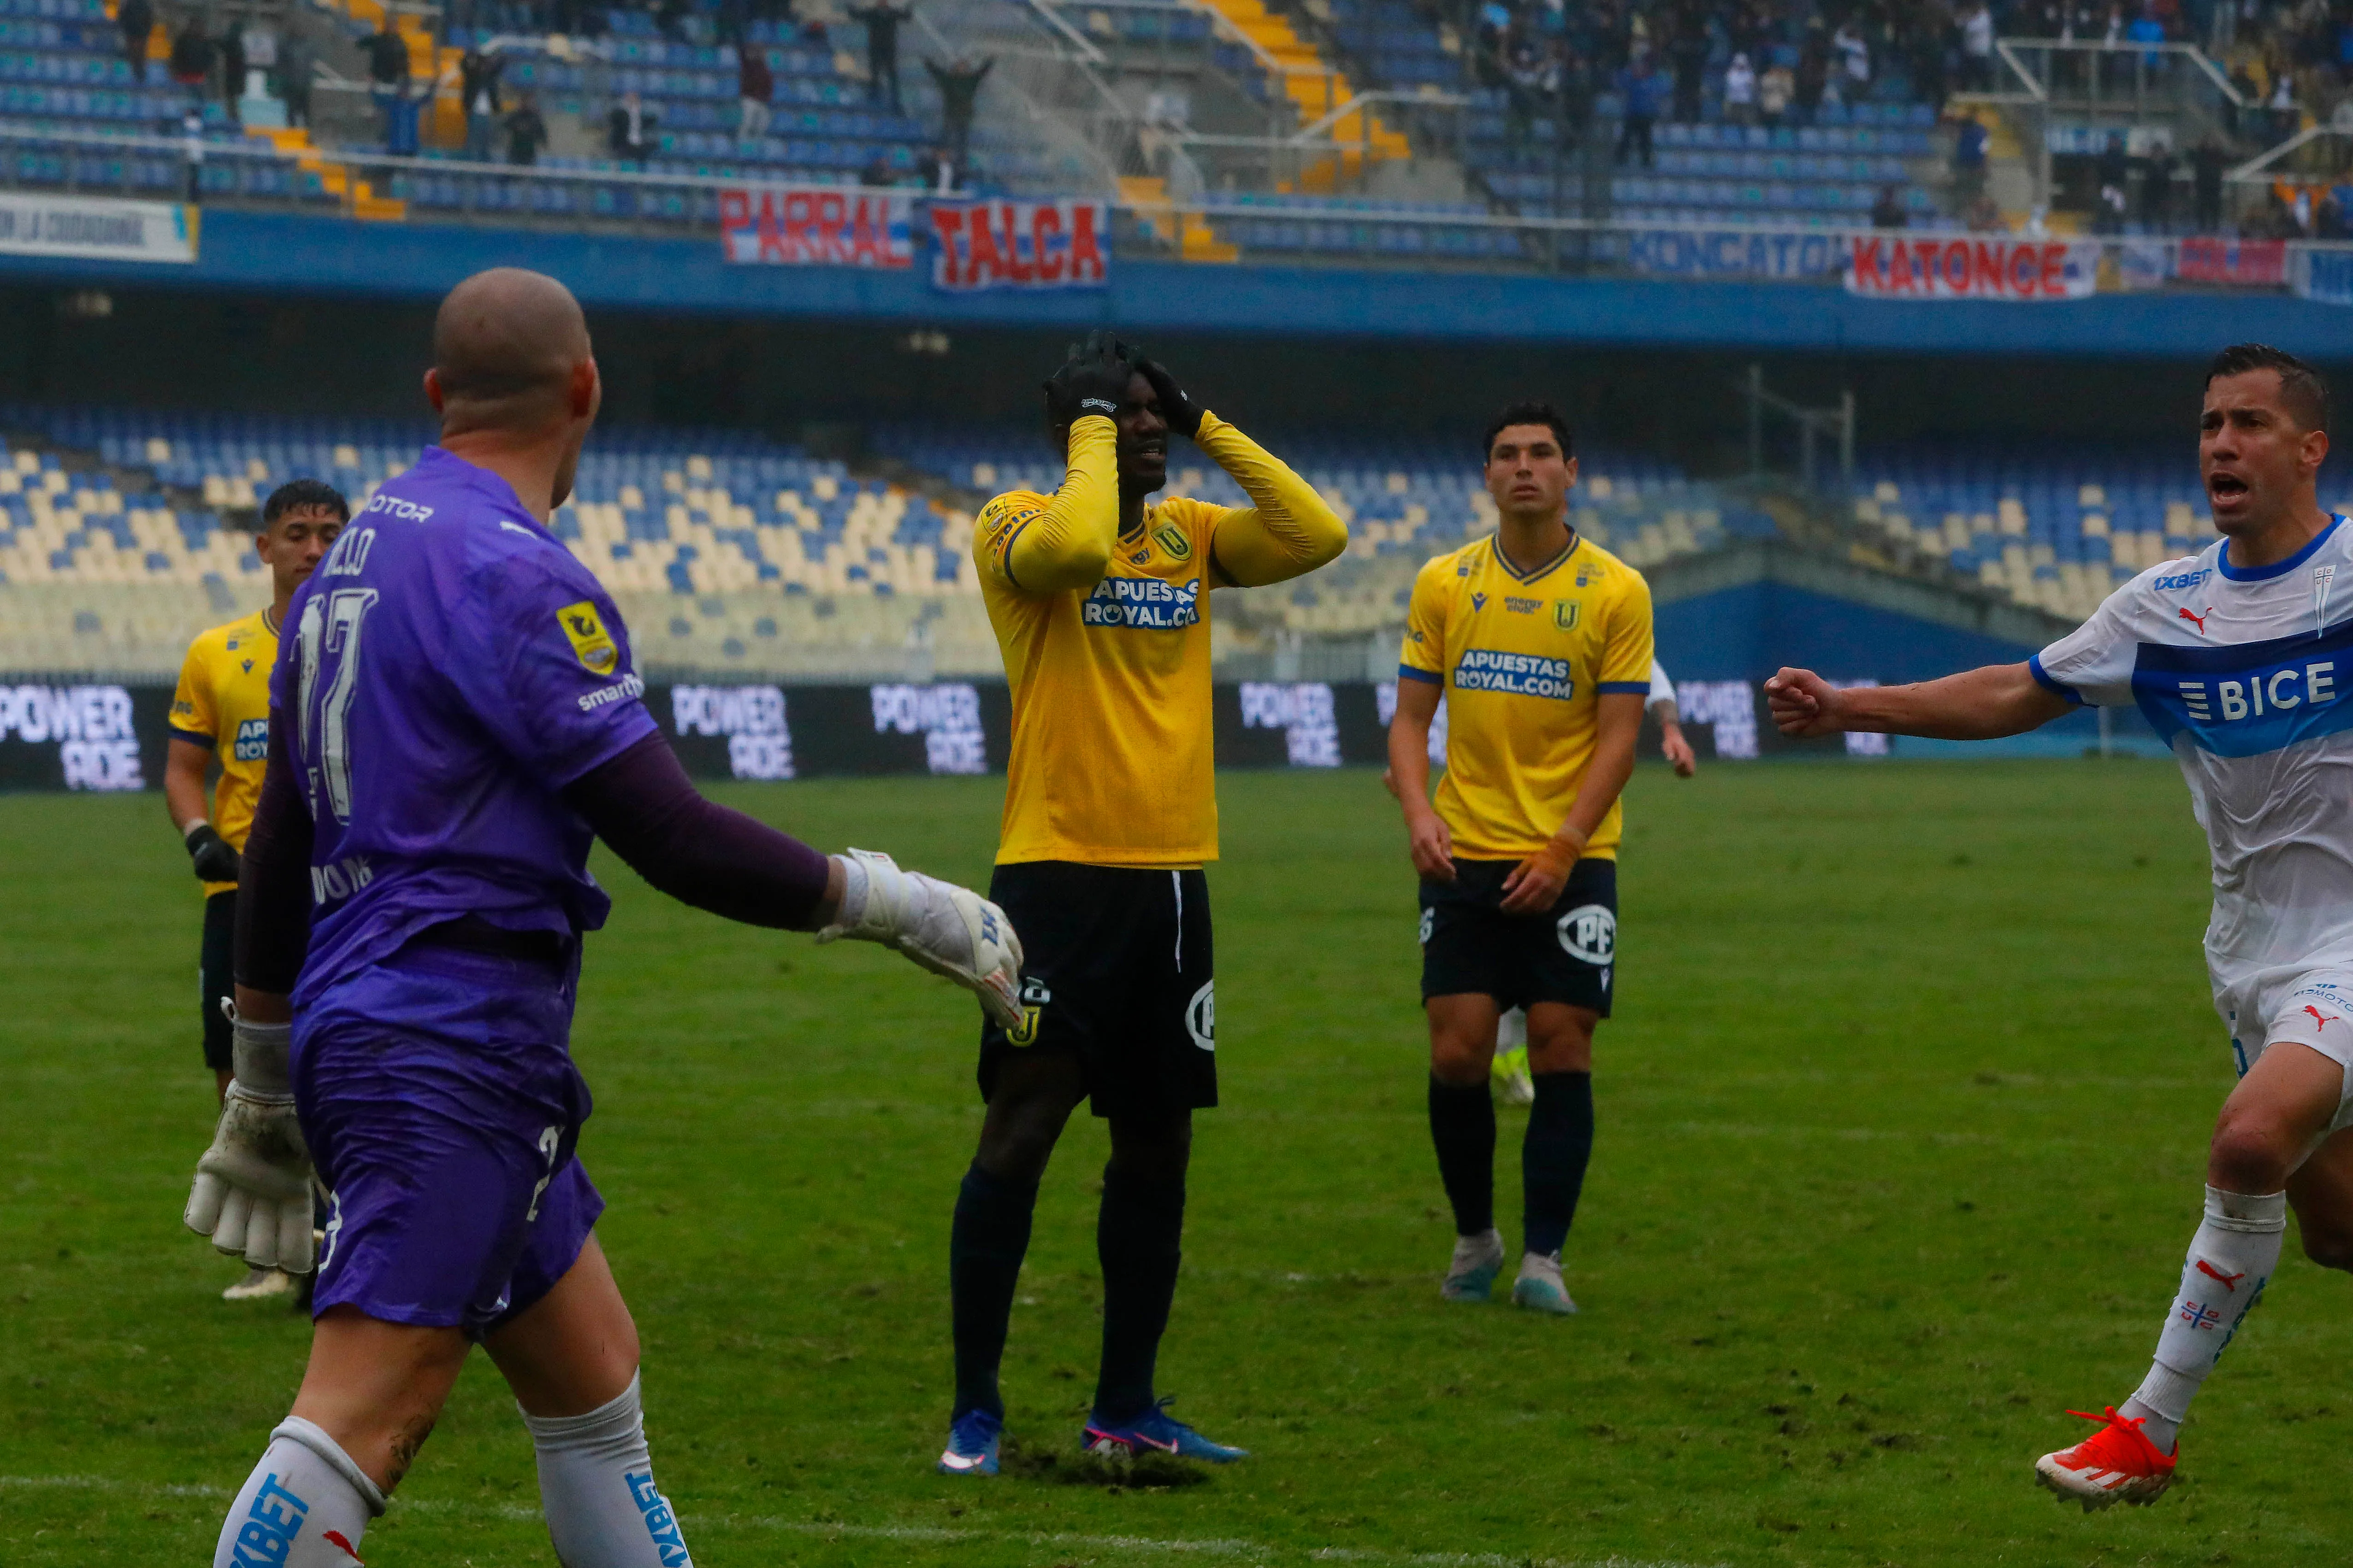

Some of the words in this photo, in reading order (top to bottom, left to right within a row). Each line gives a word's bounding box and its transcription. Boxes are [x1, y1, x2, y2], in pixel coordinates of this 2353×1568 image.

[718, 190, 914, 269] PARRAL
[931, 203, 1105, 285] TALCA
[1852, 235, 2070, 296] KATONCE
[1455, 669, 1572, 699] ROYAL.COM
[1460, 651, 1567, 679] APUESTAS
[2218, 661, 2336, 721] BICE
[671, 684, 787, 737] POWER
[871, 684, 982, 734] POWER
